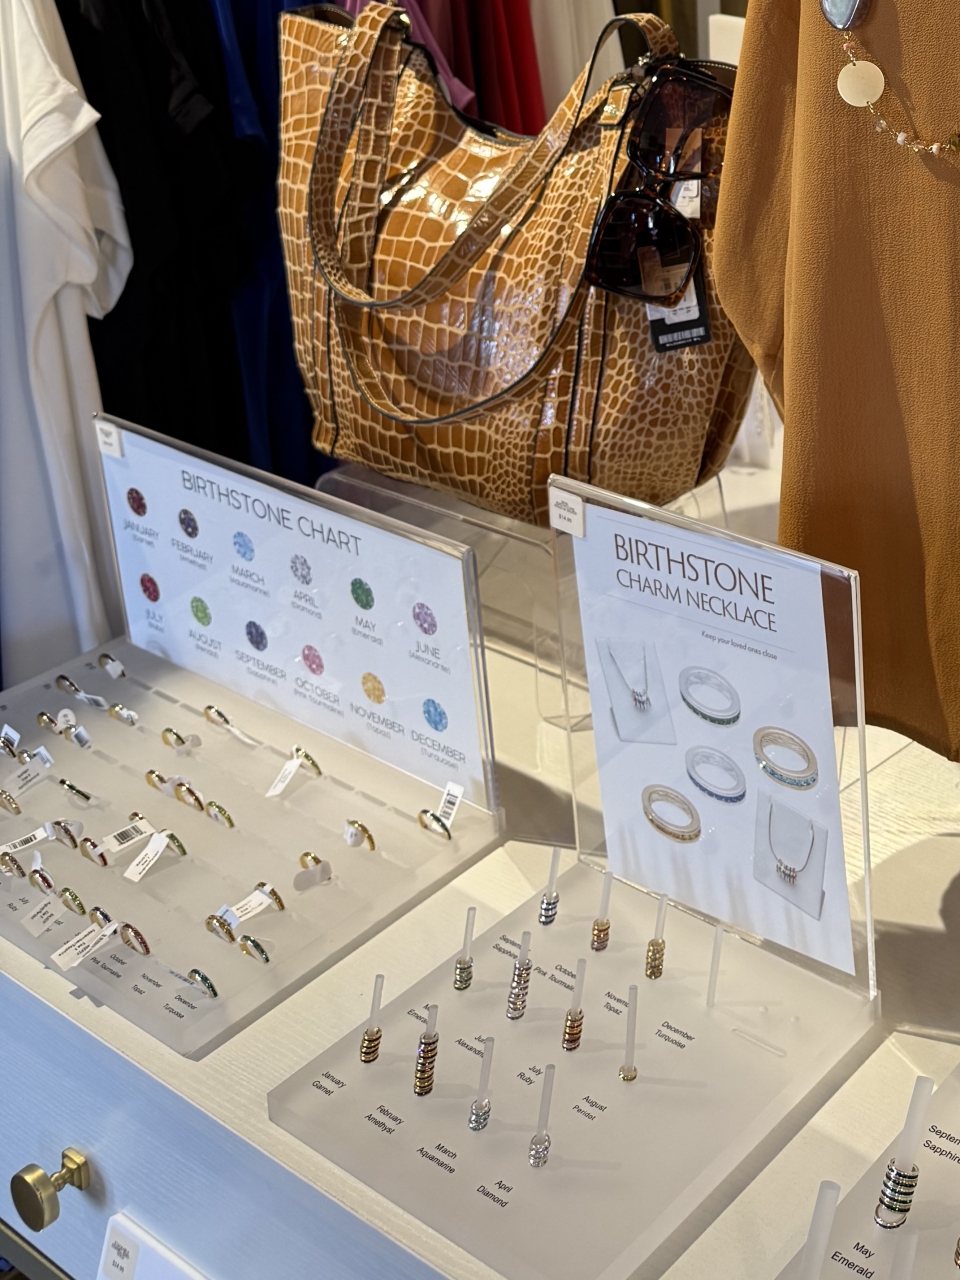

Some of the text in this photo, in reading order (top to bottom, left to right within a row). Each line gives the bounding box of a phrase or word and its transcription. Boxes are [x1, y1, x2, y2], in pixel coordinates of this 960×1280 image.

[180, 470, 362, 557] BIRTHSTONE CHART
[231, 564, 265, 586] MARCH
[614, 533, 776, 606] BIRTHSTONE
[294, 590, 319, 609] APRIL
[616, 568, 778, 633] CHARM NECKLACE
[355, 615, 376, 632] MAY
[189, 629, 222, 651] AUGUST
[701, 630, 778, 660] Keep your loved ones close
[415, 640, 441, 660] JUNE
[235, 649, 287, 681] SEPTEMBER
[295, 677, 340, 706] OCTOBER
[350, 703, 406, 736] NOVEMBER
[411, 729, 467, 764] DECEMBER
[110, 953, 128, 966] October
[492, 943, 518, 960] Sapphire
[141, 972, 163, 989] November
[533, 966, 549, 978] Pink
[555, 964, 577, 980] Octobe
[132, 984, 146, 996] Topaz
[163, 1003, 185, 1019] Turquoise
[174, 994, 198, 1010] December
[603, 1002, 623, 1016] Topaz
[655, 1029, 686, 1050] Turquoise
[661, 1021, 696, 1042] December
[516, 1071, 536, 1086] Ruby
[528, 1065, 544, 1076] July
[312, 1080, 335, 1097] Garnet
[321, 1071, 347, 1089] January
[572, 1104, 597, 1121] Peridot
[582, 1095, 608, 1112] August
[364, 1113, 396, 1135] Amethyst
[376, 1104, 405, 1126] February
[434, 1142, 458, 1160] March
[416, 1147, 456, 1174] Aquamarine
[494, 1180, 514, 1194] April
[476, 1185, 509, 1208] Diamond
[853, 1242, 876, 1259] May
[830, 1250, 875, 1280] Emerald
